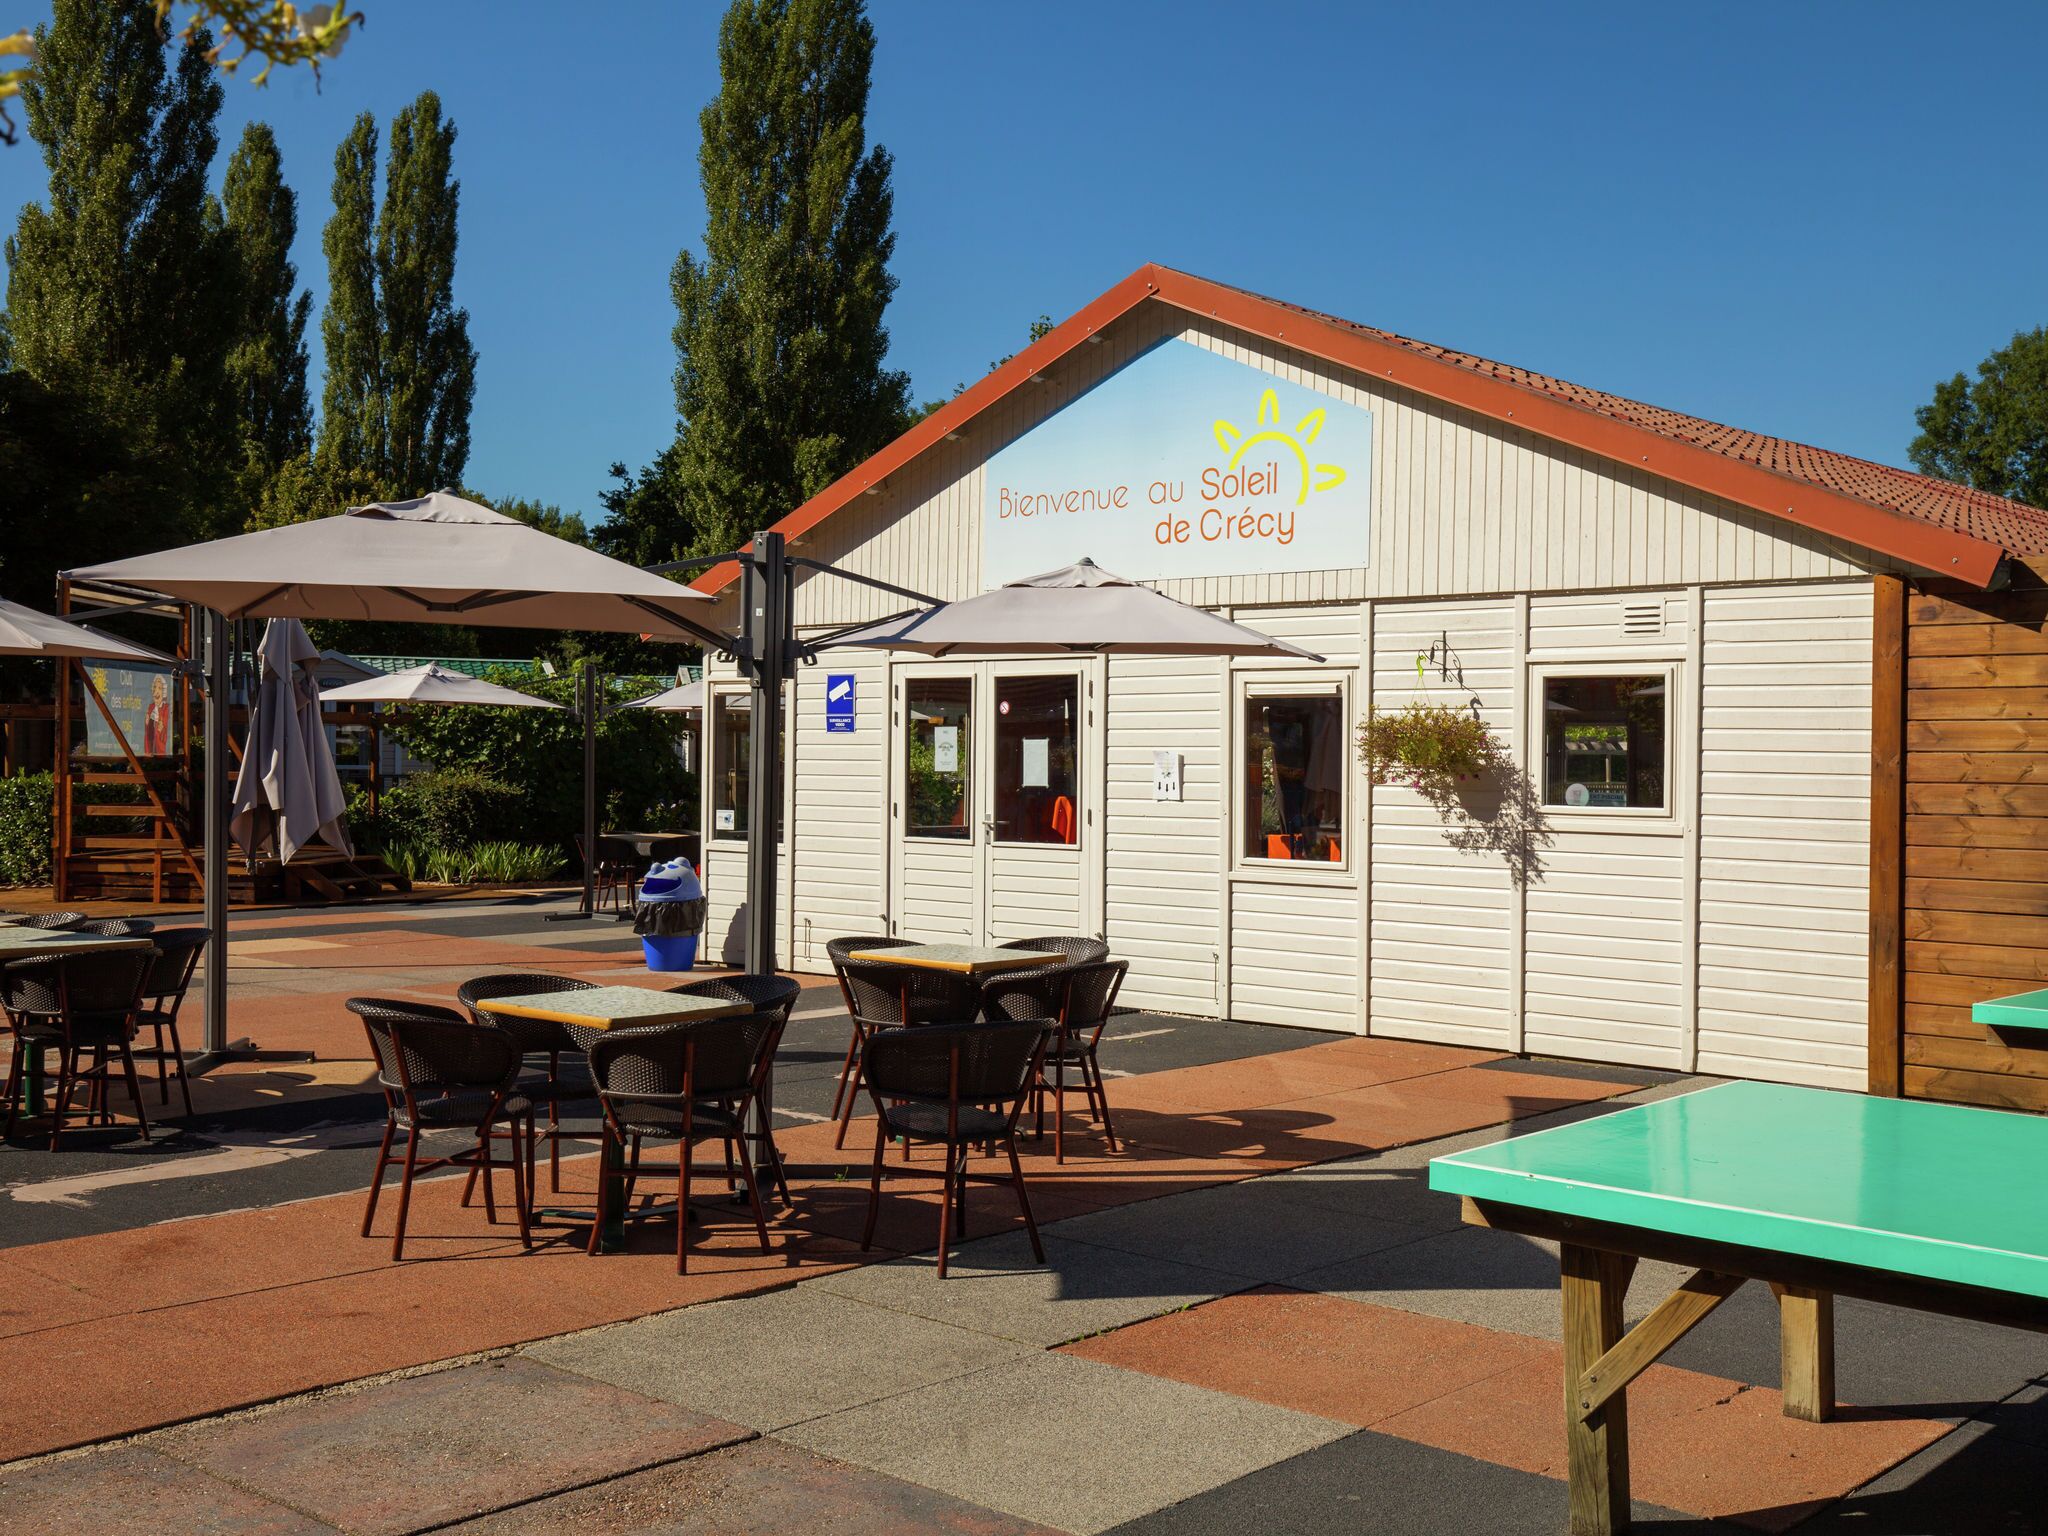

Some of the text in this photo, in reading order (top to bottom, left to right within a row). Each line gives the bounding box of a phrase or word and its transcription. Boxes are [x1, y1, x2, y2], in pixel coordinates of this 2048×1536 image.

[1000, 462, 1278, 519] Bienvenue au Soleil
[1155, 507, 1295, 545] de Crécy
[112, 693, 122, 709] des
